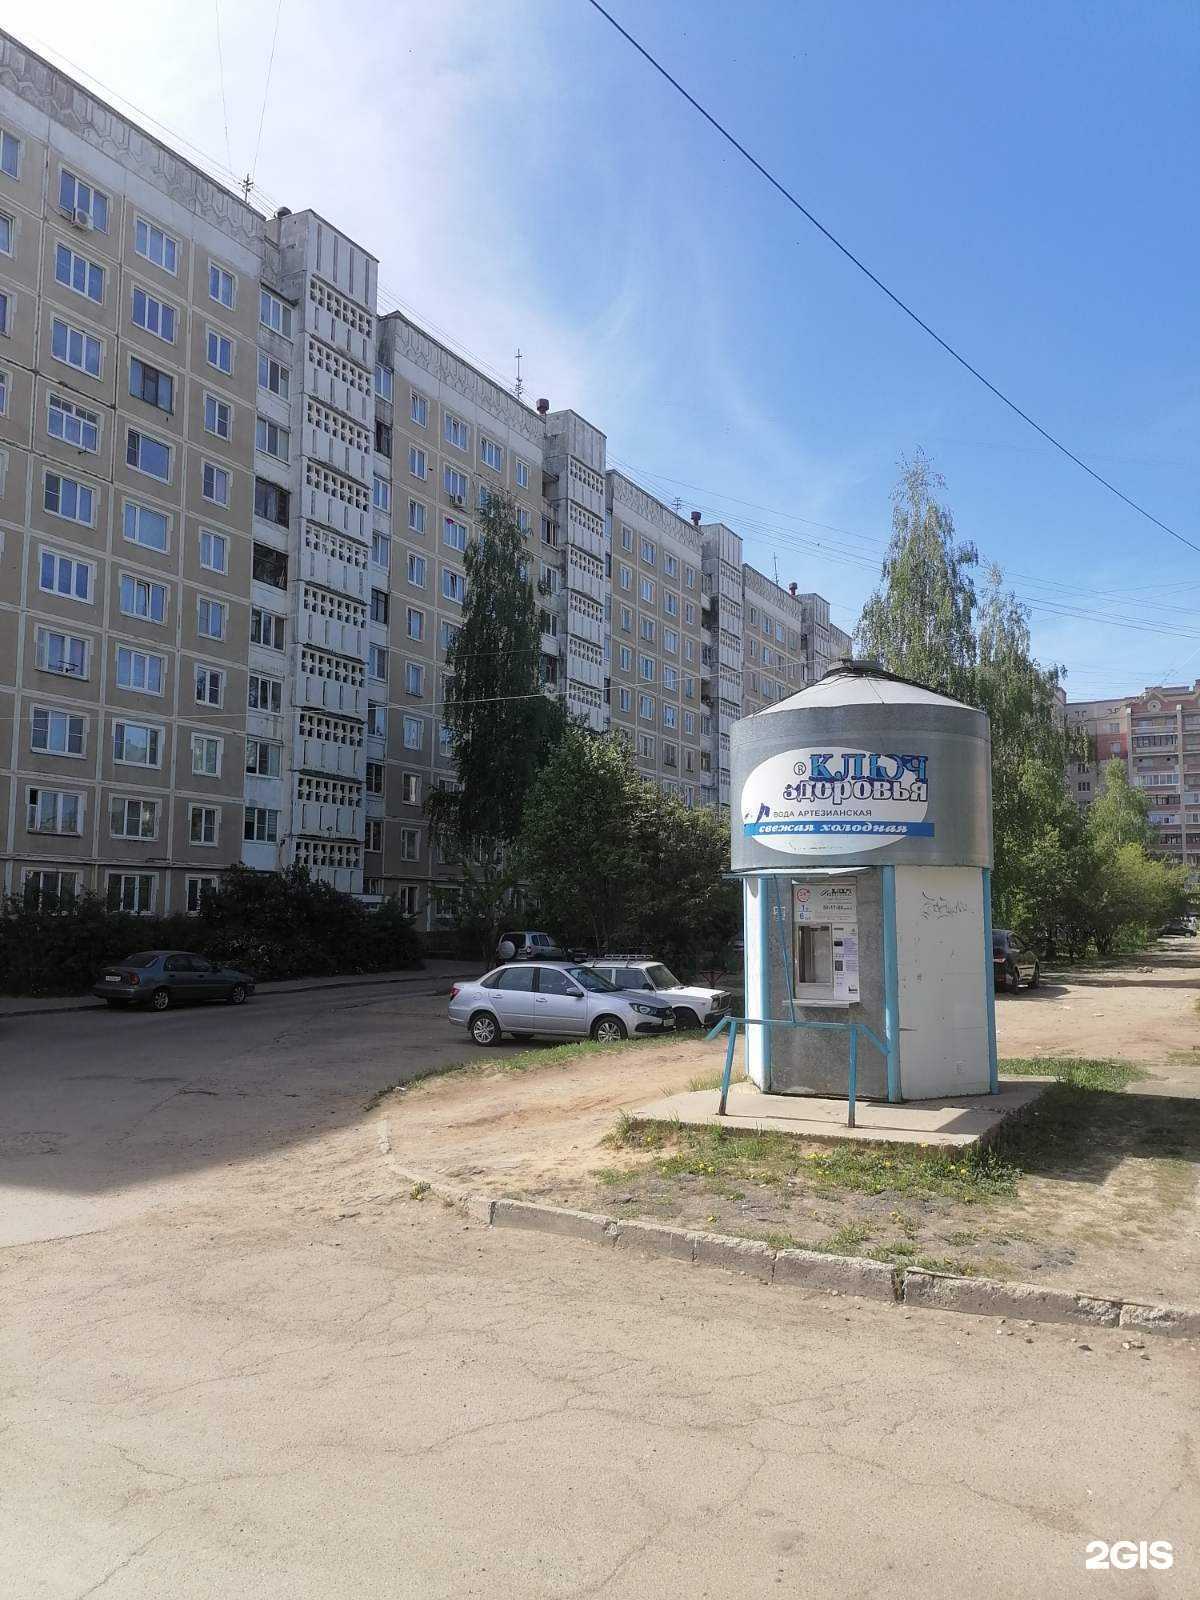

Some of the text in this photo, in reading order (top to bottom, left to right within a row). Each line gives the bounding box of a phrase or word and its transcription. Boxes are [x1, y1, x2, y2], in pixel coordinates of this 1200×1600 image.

[808, 754, 928, 784] КЛЮЧ
[798, 809, 872, 818] АРТЕЗИАНСКАЯ
[758, 823, 814, 833] свежая
